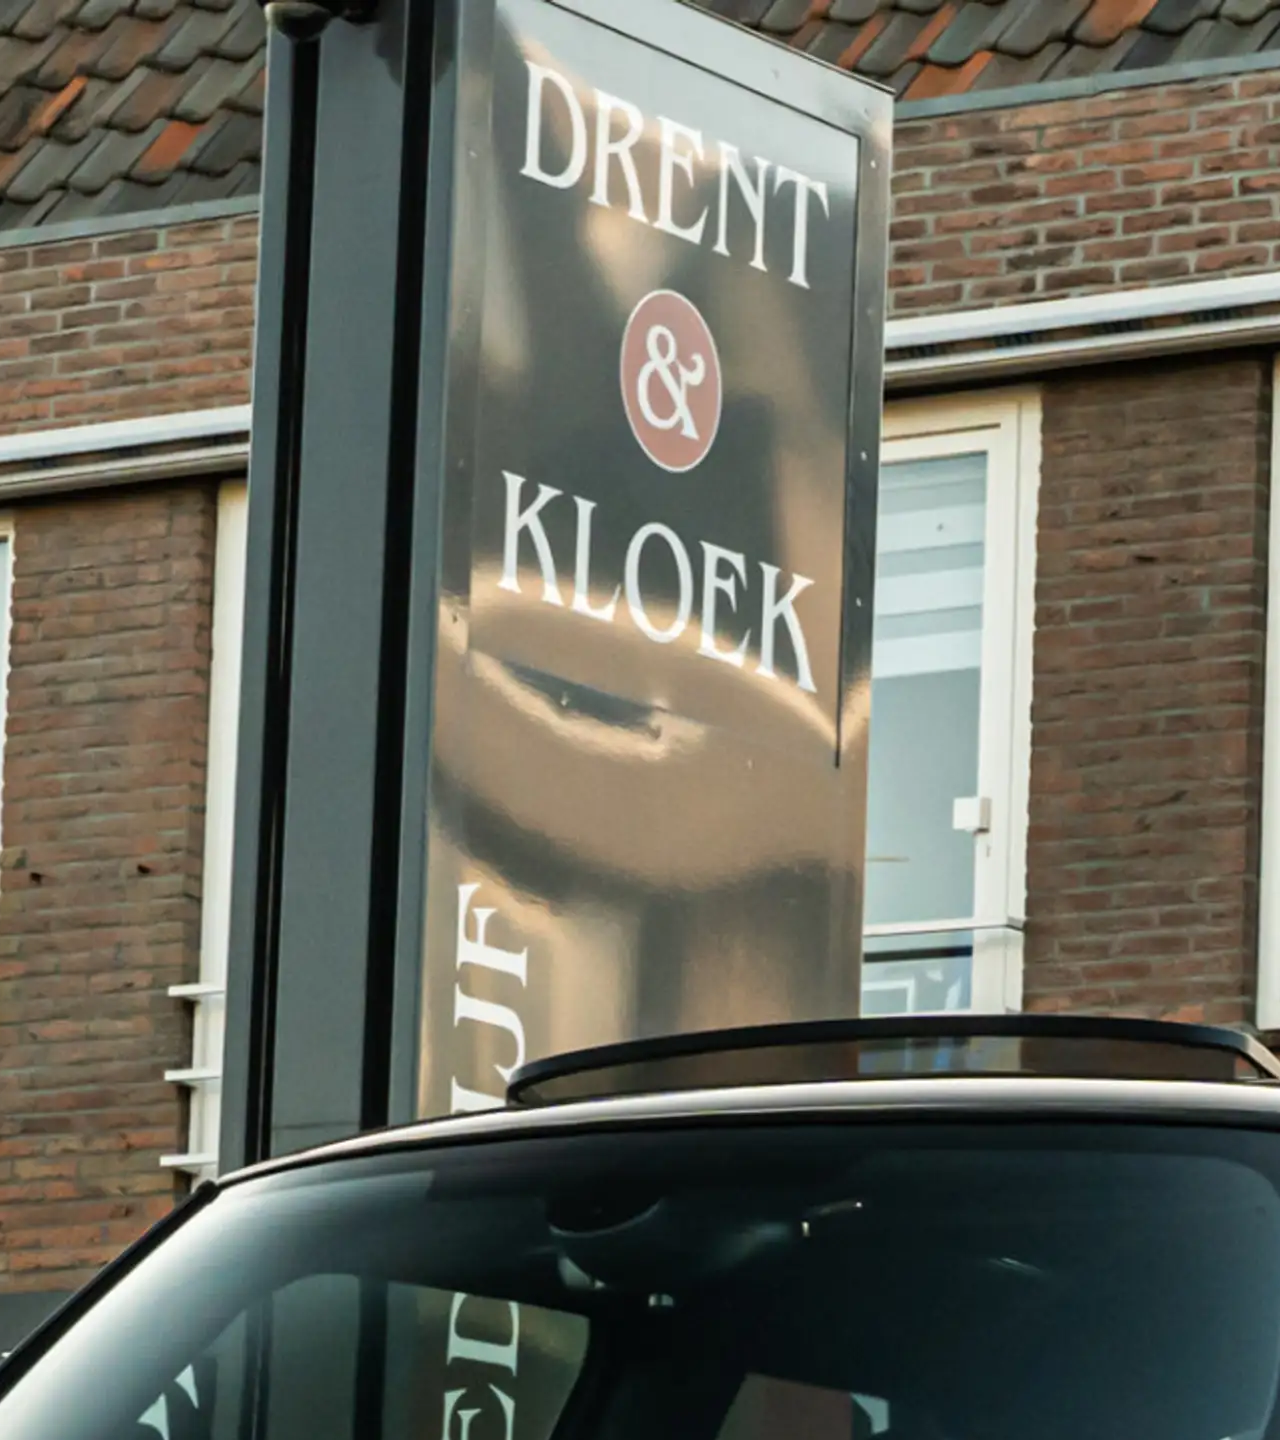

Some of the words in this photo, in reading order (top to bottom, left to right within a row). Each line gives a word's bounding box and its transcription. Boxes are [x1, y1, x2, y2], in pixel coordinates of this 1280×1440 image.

[520, 60, 830, 290] DRENT
[637, 323, 706, 442] &
[497, 469, 818, 693] KLOEK
